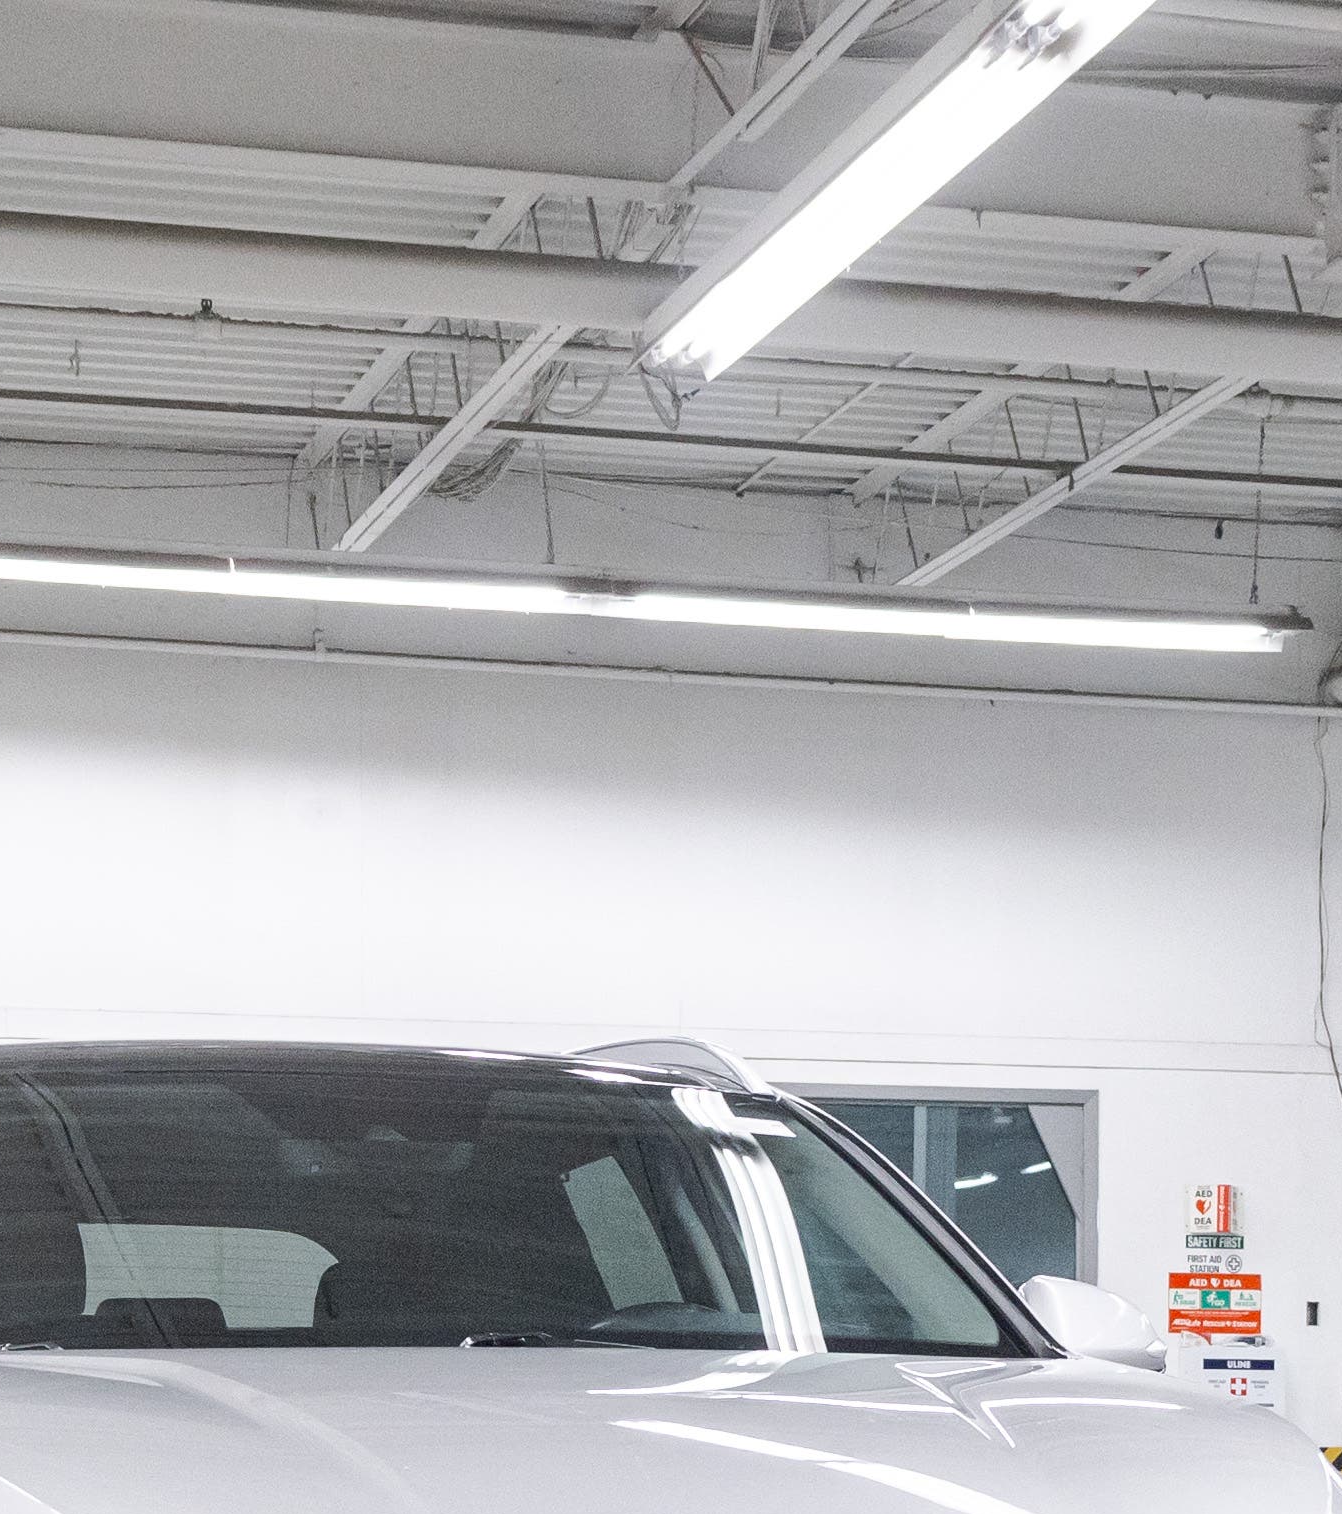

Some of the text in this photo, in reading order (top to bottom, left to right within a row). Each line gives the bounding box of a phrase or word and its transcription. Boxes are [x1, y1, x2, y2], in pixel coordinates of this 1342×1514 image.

[1195, 1190, 1213, 1198] AED
[1194, 1217, 1212, 1225] DEA
[1187, 1236, 1242, 1249] SAFETY FIRST
[1187, 1254, 1222, 1264] FIRST AID
[1189, 1264, 1220, 1273] STATION
[1189, 1278, 1242, 1288] AED DEA
